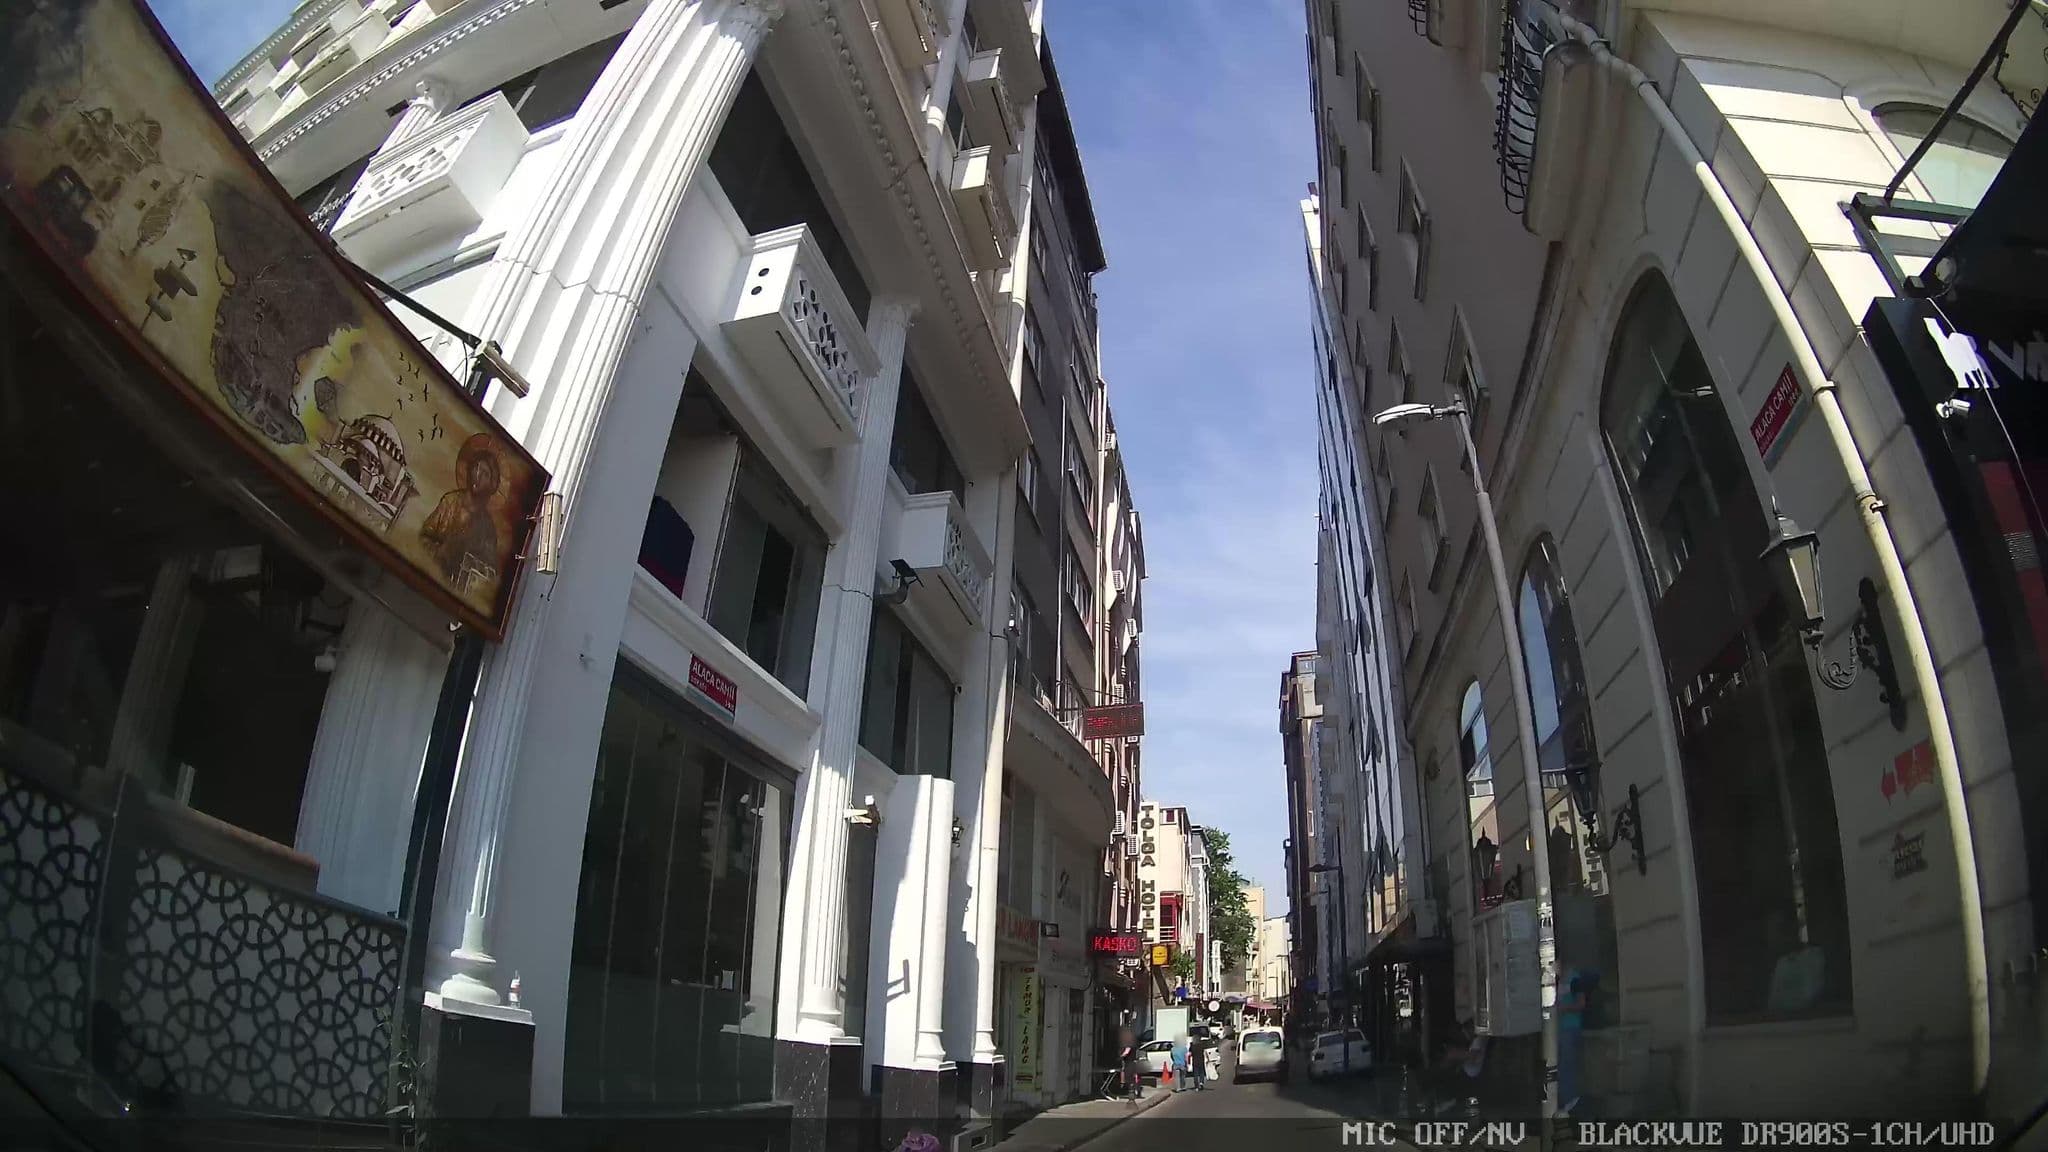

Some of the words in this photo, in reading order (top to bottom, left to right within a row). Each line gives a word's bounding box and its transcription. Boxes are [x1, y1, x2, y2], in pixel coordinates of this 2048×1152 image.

[1754, 406, 1776, 442] ALACA
[692, 661, 715, 687] ALACA
[1140, 805, 1156, 867] TOLGA
[1140, 879, 1156, 943] HOTEL
[1092, 936, 1137, 952] KASKO
